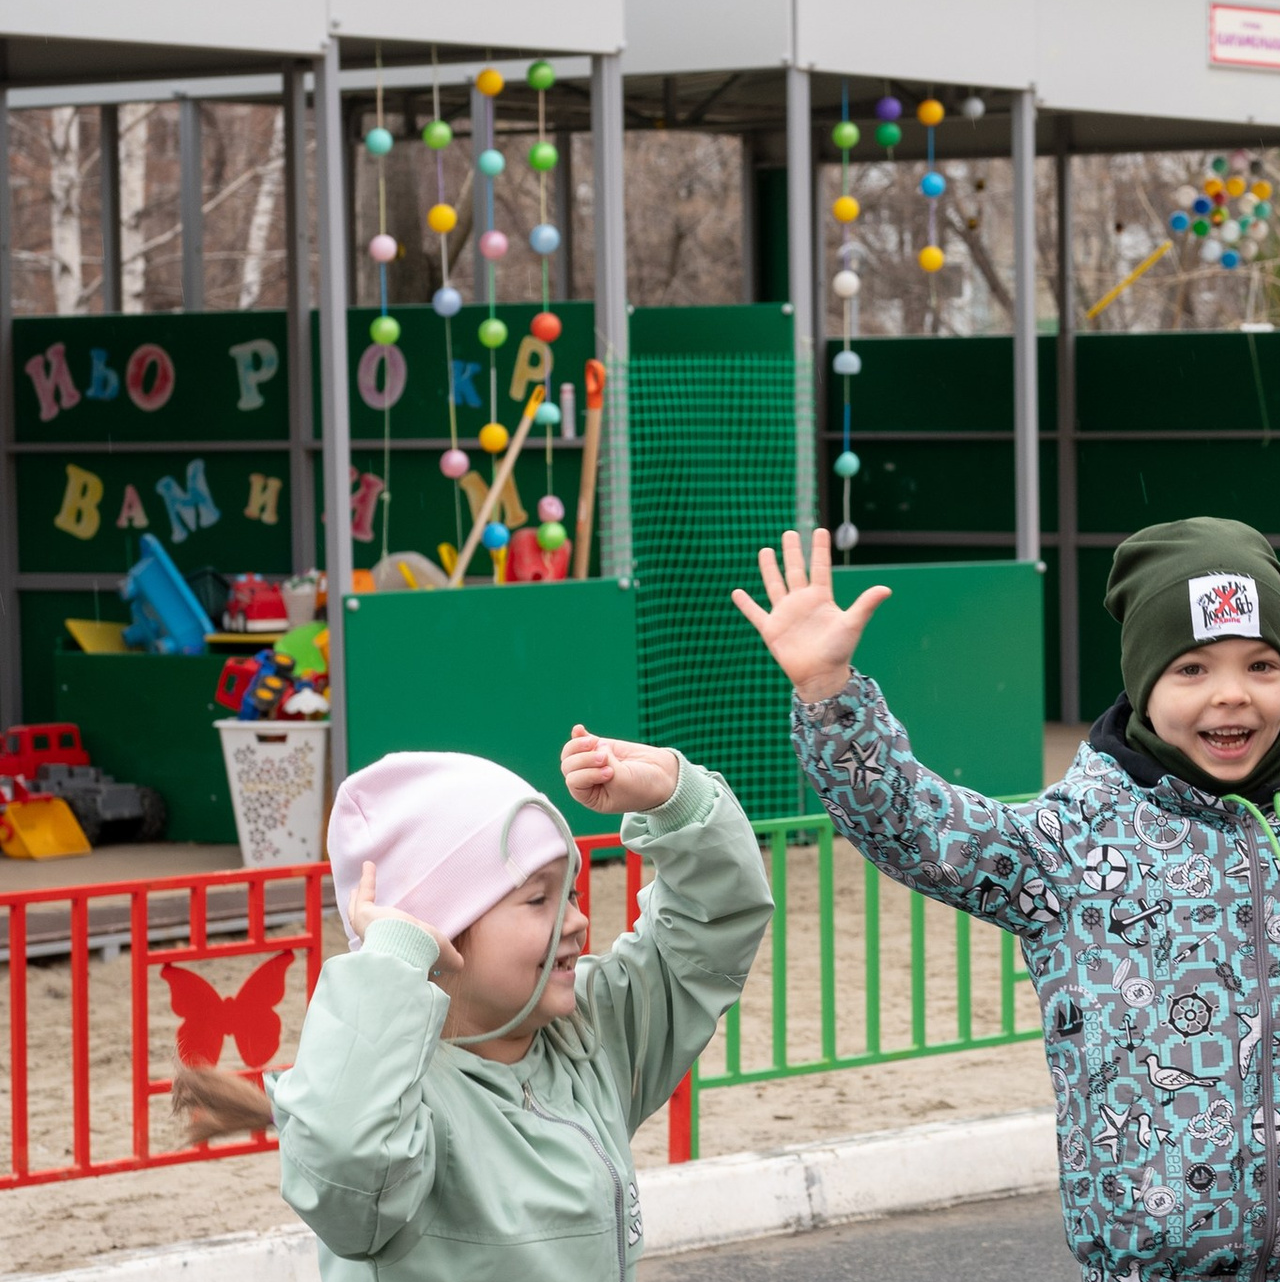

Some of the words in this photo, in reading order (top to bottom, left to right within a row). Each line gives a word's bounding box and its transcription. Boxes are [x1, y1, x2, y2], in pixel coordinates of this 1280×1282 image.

[1084, 1011, 1099, 1044] sea
[1166, 1145, 1181, 1176] sea
[1168, 1216, 1182, 1246] sea
